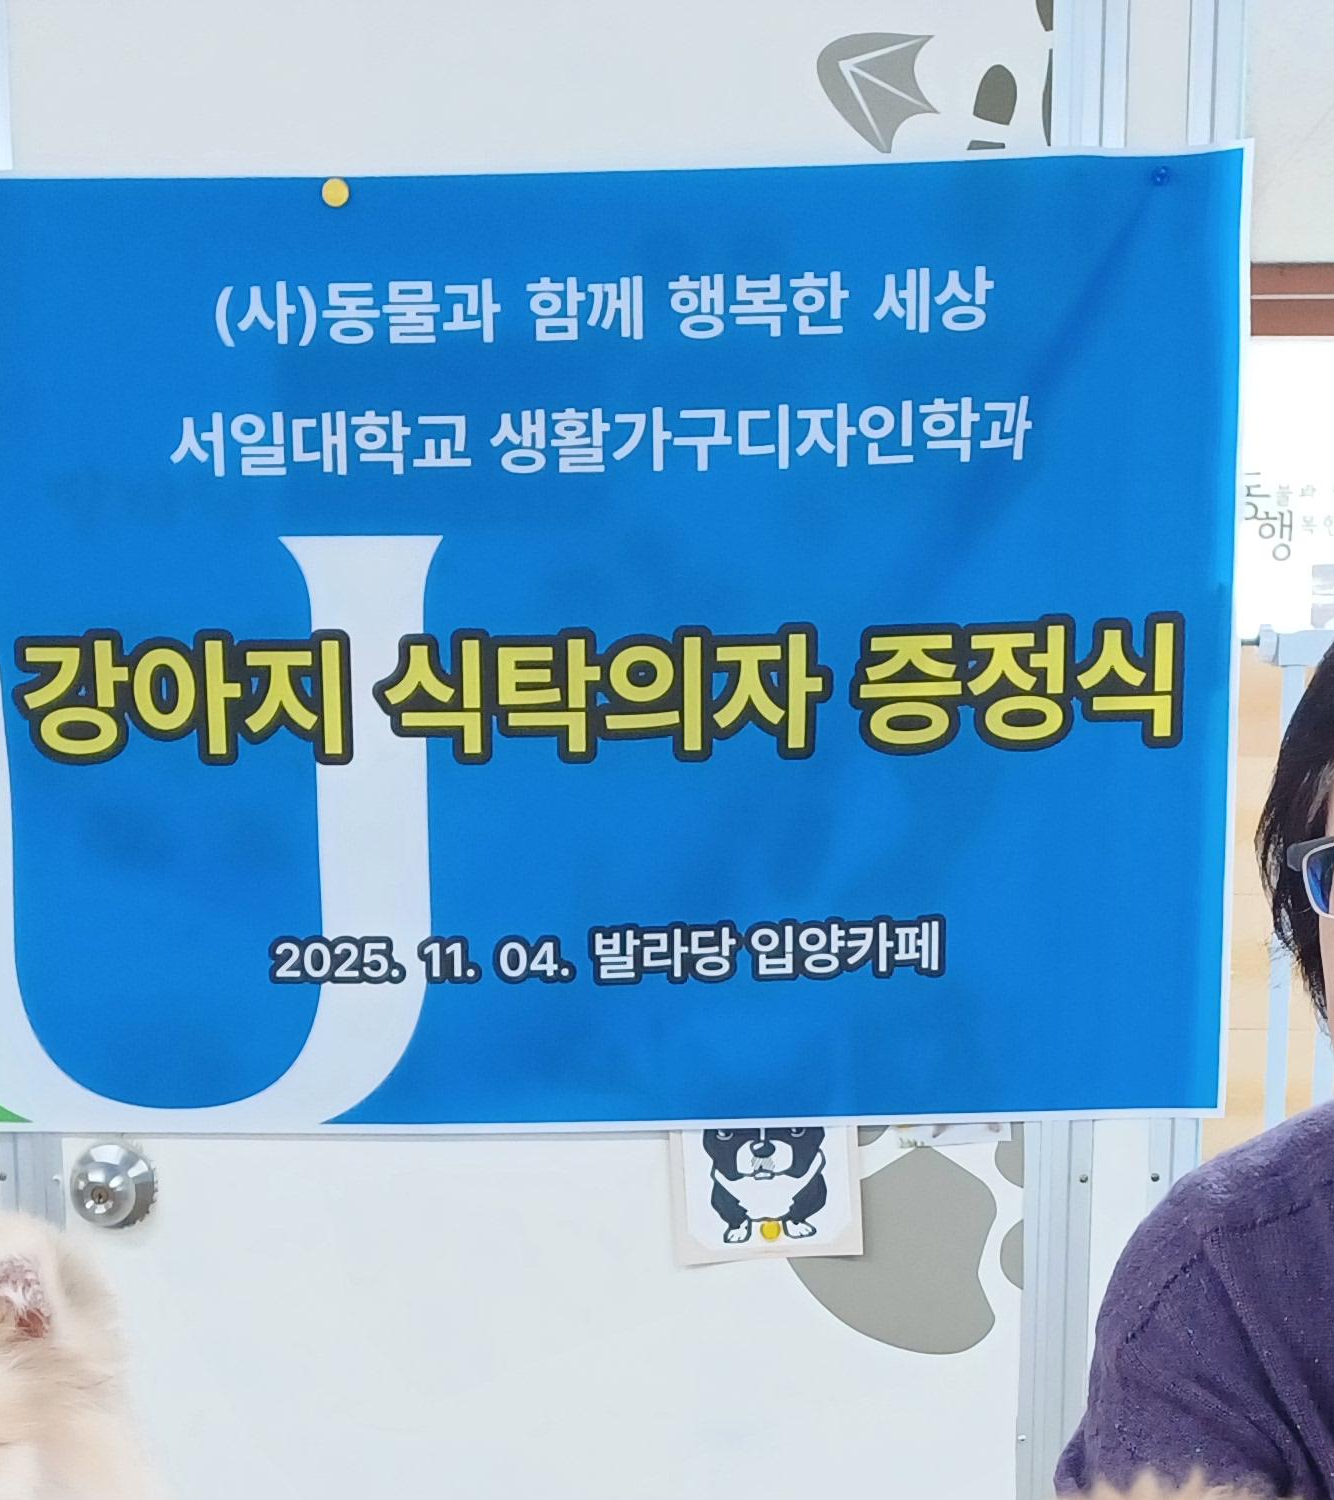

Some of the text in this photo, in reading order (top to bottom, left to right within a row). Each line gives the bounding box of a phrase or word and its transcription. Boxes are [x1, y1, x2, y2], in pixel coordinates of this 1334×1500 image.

[215, 265, 995, 348] (사)동물과 함께 행복한 세상
[170, 395, 1033, 477] 서일대학교 생활가구디자인학과
[19, 621, 1176, 759] 강아지 식탁의자 증정식
[273, 918, 943, 981] 2025. 11. 04. 발라당 입양카페
